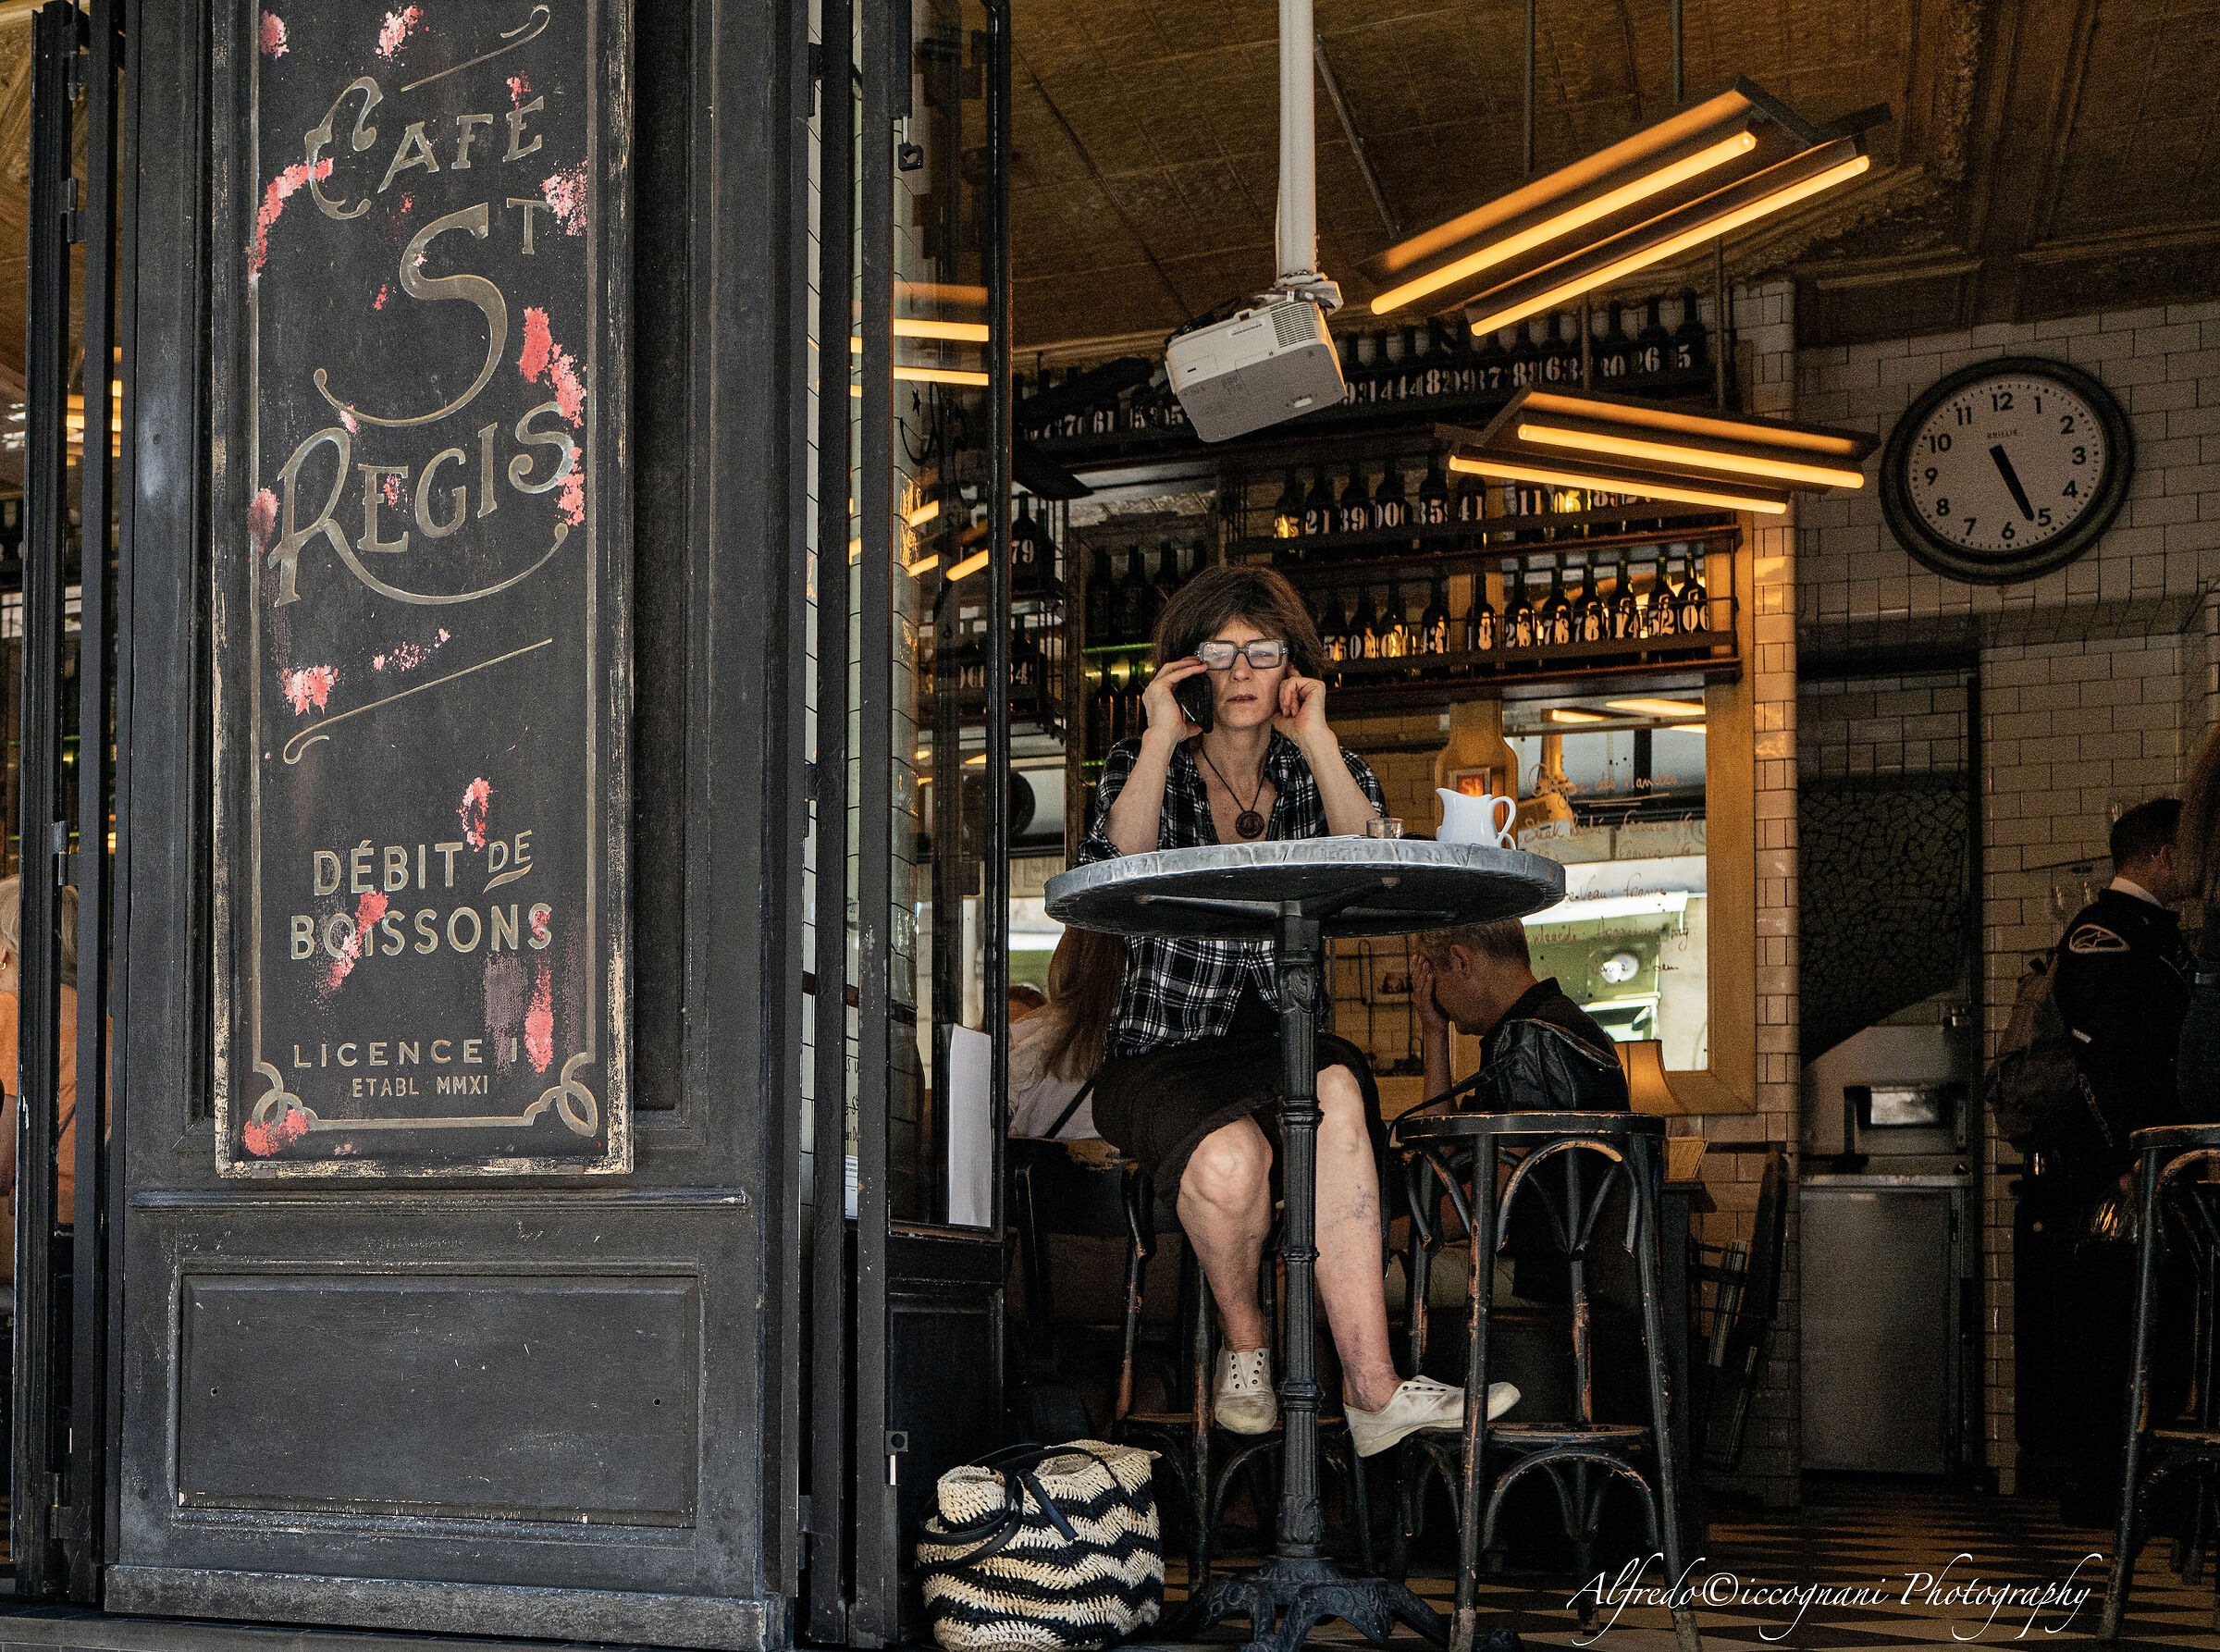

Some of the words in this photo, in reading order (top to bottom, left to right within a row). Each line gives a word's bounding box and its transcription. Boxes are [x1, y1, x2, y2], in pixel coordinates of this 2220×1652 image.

[1991, 391, 2015, 413] 12
[2034, 395, 2042, 414] 1
[1955, 406, 1972, 426] 11
[2059, 414, 2075, 436] 2
[1929, 433, 1953, 454] 10
[2071, 445, 2087, 466] 3
[1924, 467, 1939, 487] 9
[2062, 479, 2078, 499] 4
[268, 401, 575, 608] REGIS
[1935, 498, 1951, 517] 8
[1963, 518, 1978, 536] 7
[2037, 508, 2052, 527] 5
[2001, 521, 2016, 540] 6
[313, 839, 464, 896] DÉBIT
[487, 829, 534, 875] DE
[290, 902, 553, 960] BOISSONS
[293, 1038, 484, 1068] LICENCE
[352, 1077, 420, 1098] ETABL
[436, 1074, 489, 1096] MMXI
